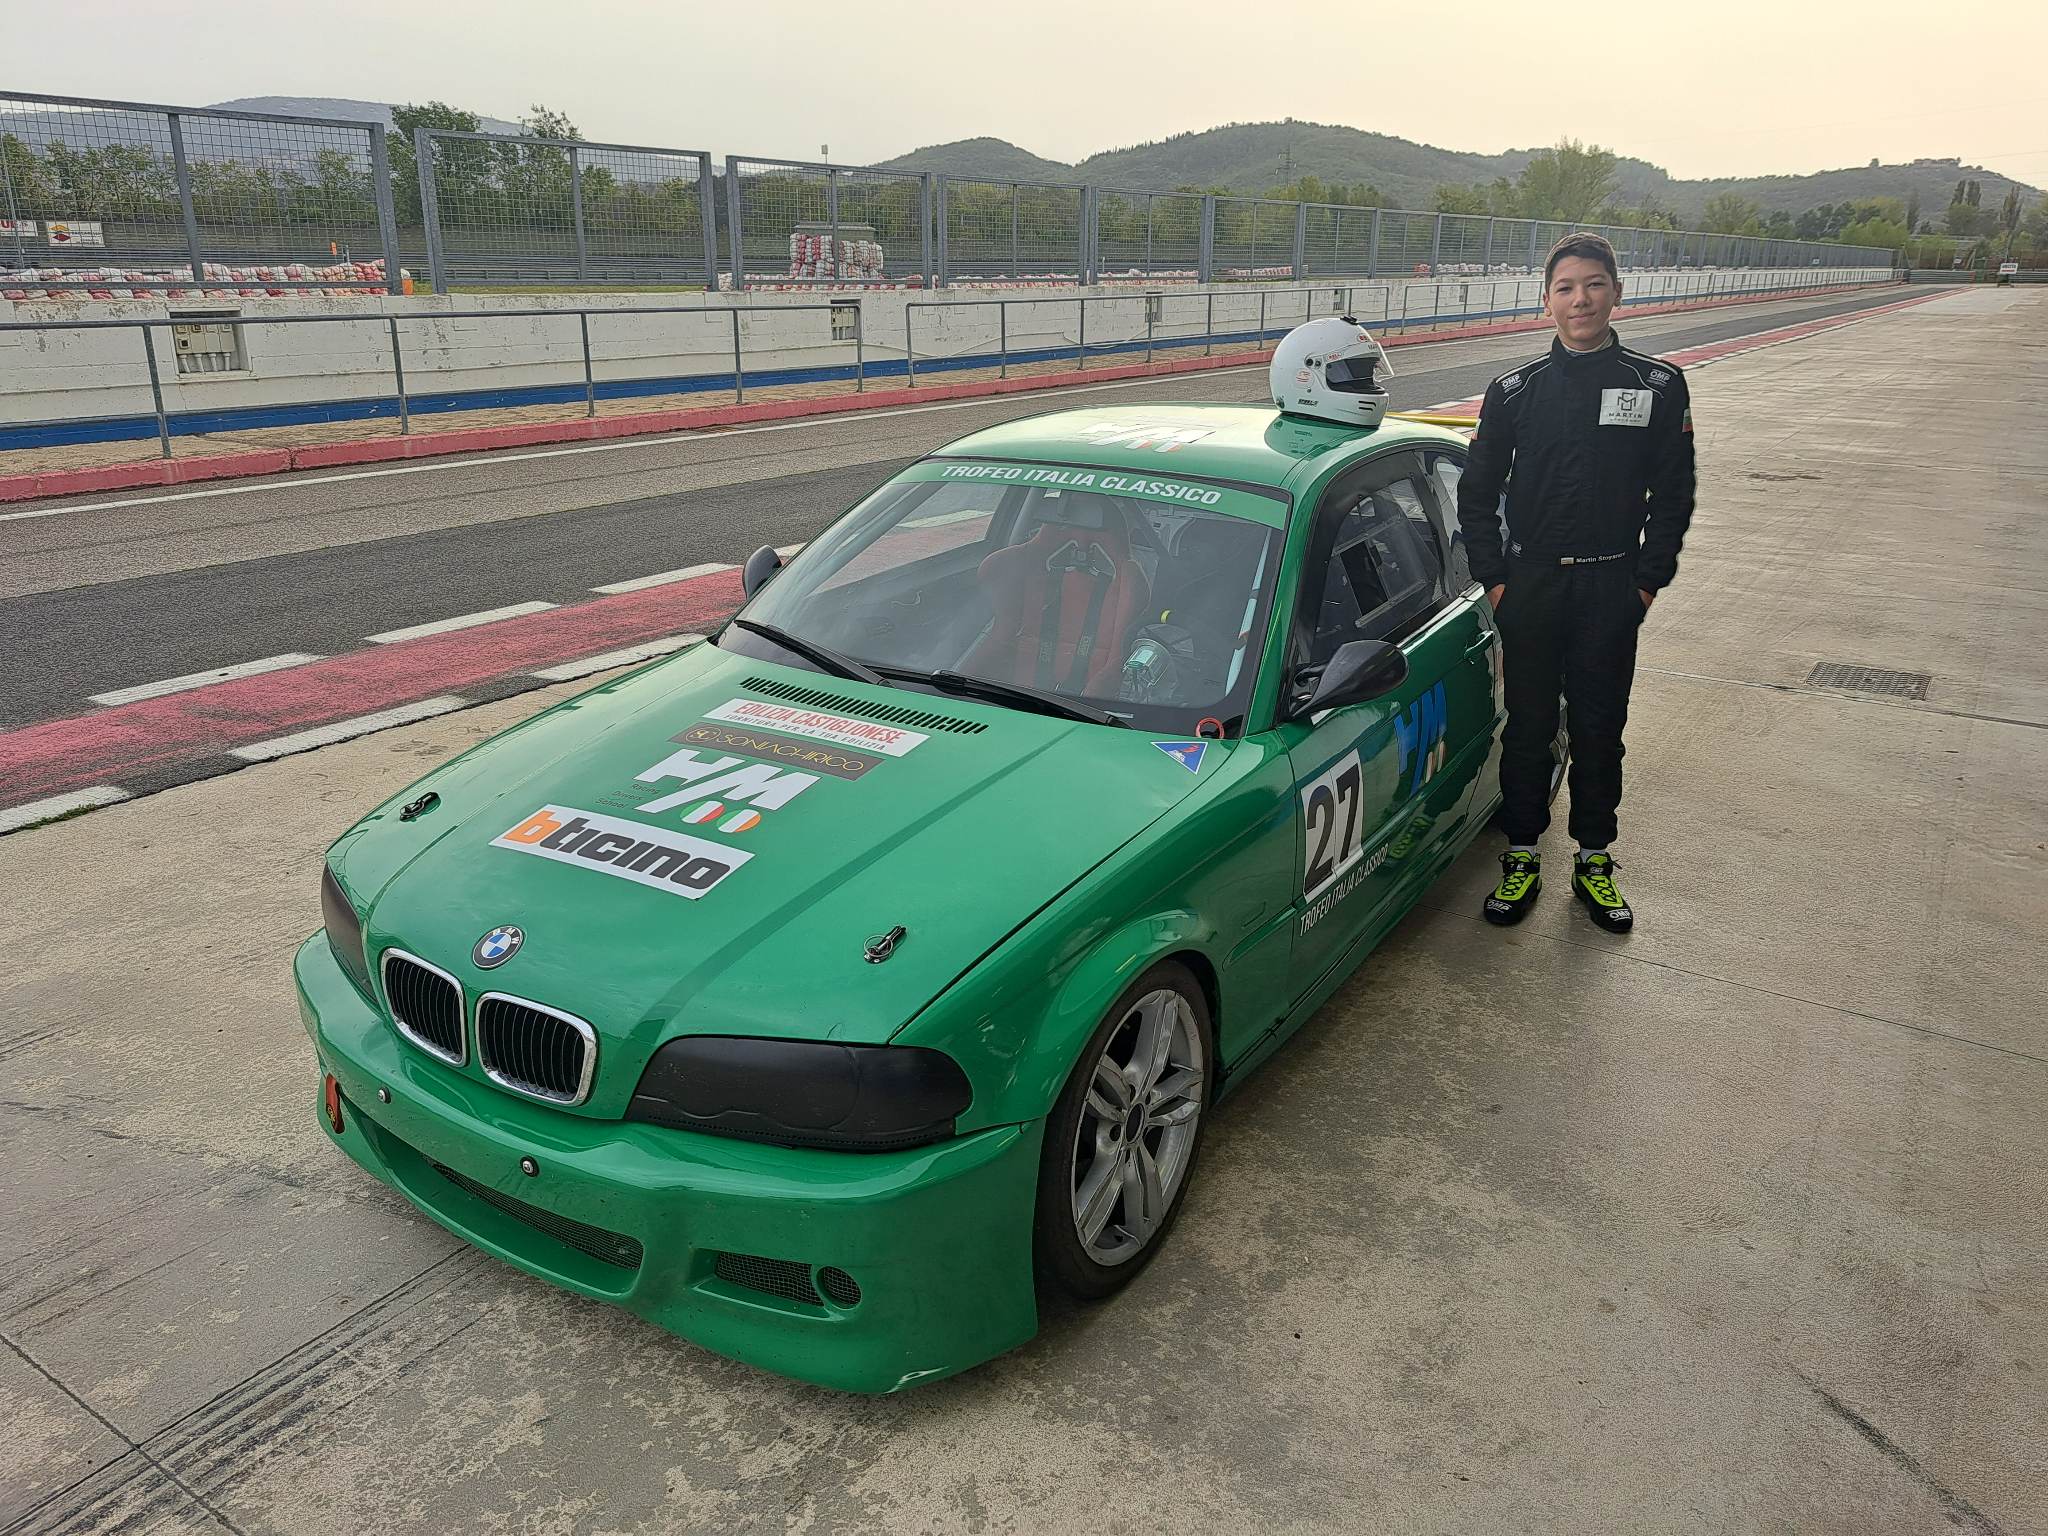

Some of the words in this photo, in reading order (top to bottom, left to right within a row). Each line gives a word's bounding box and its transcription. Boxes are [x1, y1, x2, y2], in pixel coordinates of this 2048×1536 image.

[1650, 370, 1671, 382] OMP
[941, 465, 1021, 479] TROFEO
[1023, 469, 1097, 488] ITALIA
[1099, 476, 1222, 505] CLASSICO
[1576, 556, 1597, 564] Martin
[723, 714, 778, 728] FORNITURA
[780, 723, 798, 732] PER
[801, 726, 816, 736] LA
[818, 730, 838, 741] TUA
[841, 735, 887, 751] EDILIZIA
[734, 702, 794, 723] EDILIZIA
[791, 710, 908, 745] CASTIGLIONESE
[595, 797, 628, 809] School
[632, 783, 660, 795] Racing
[1303, 763, 1361, 896] 27
[503, 810, 731, 890] bticino
[1300, 893, 1331, 937] TROFEO
[1329, 871, 1356, 911] ITALIA
[1354, 842, 1389, 887] CLASSICO
[491, 926, 521, 945] BMW
